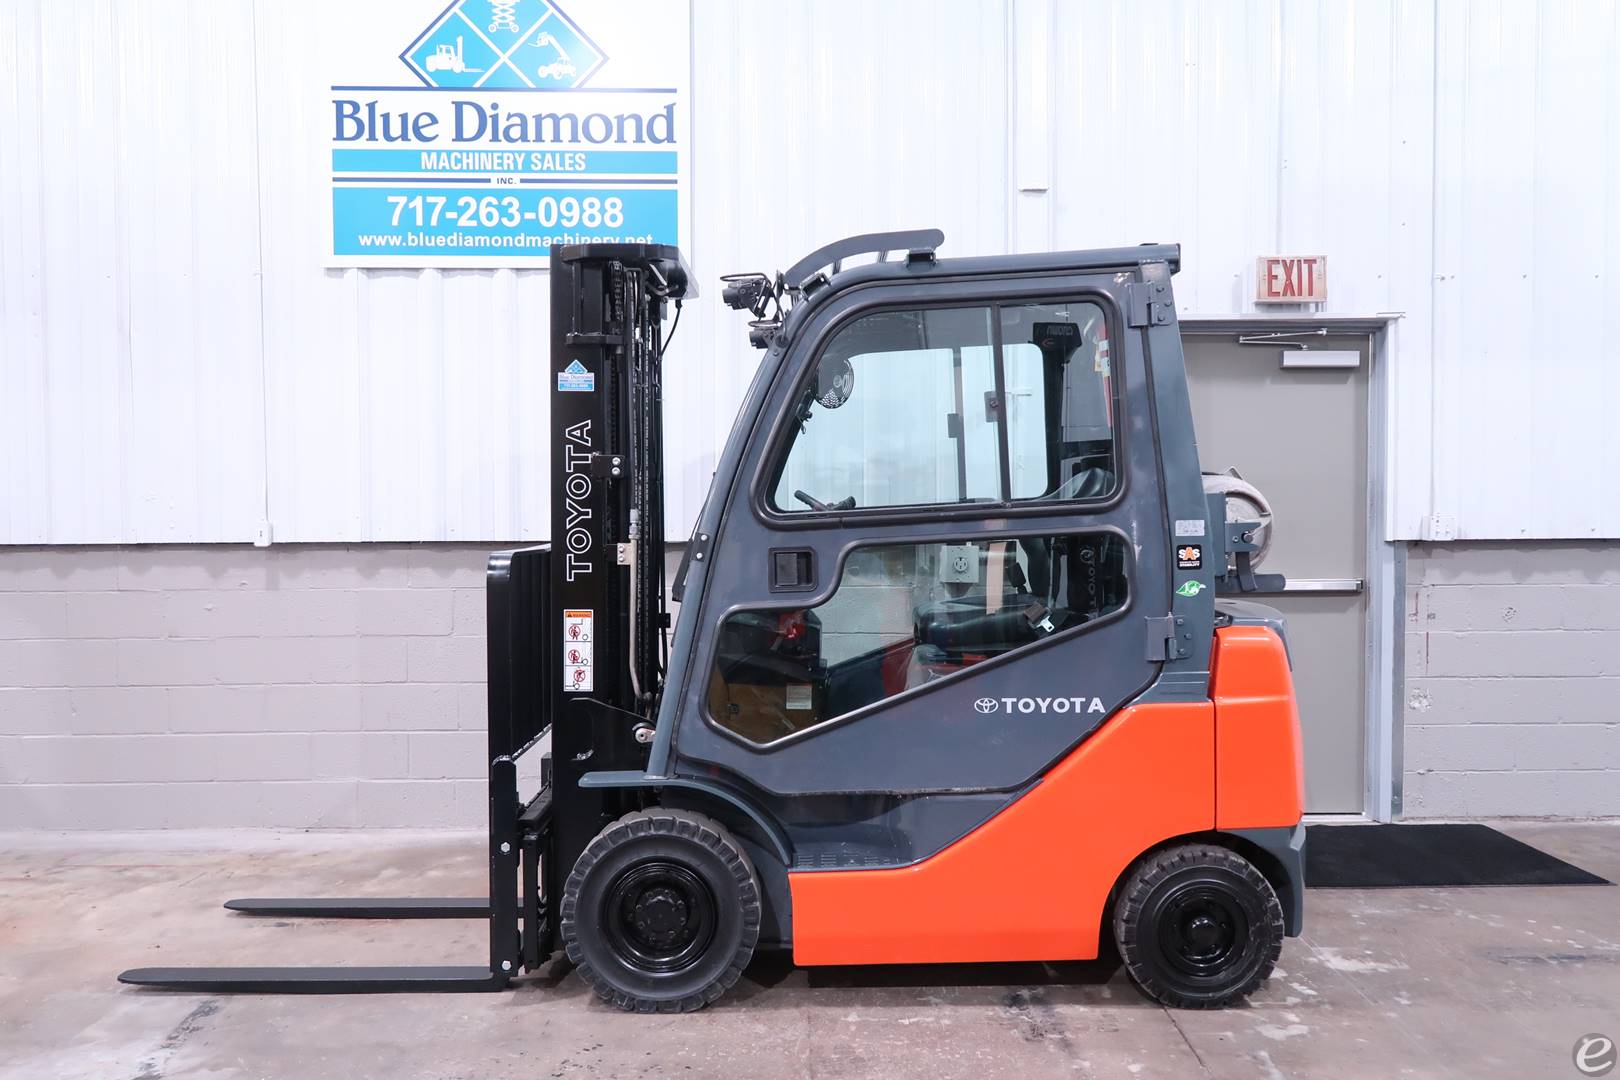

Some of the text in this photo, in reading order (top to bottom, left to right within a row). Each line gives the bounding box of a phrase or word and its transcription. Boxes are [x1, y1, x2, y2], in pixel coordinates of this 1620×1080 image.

[331, 99, 677, 144] Blue Diamond
[420, 152, 586, 171] MACHINERY SALES
[496, 177, 517, 185] INC.
[386, 196, 624, 228] 717-263-0988
[358, 231, 653, 248] www.bluediamondmachinerynet
[1266, 258, 1317, 297] EXIT
[565, 419, 593, 582] TOYOTA
[1178, 546, 1201, 561] SAS
[1001, 697, 1106, 714] TOYOTA
